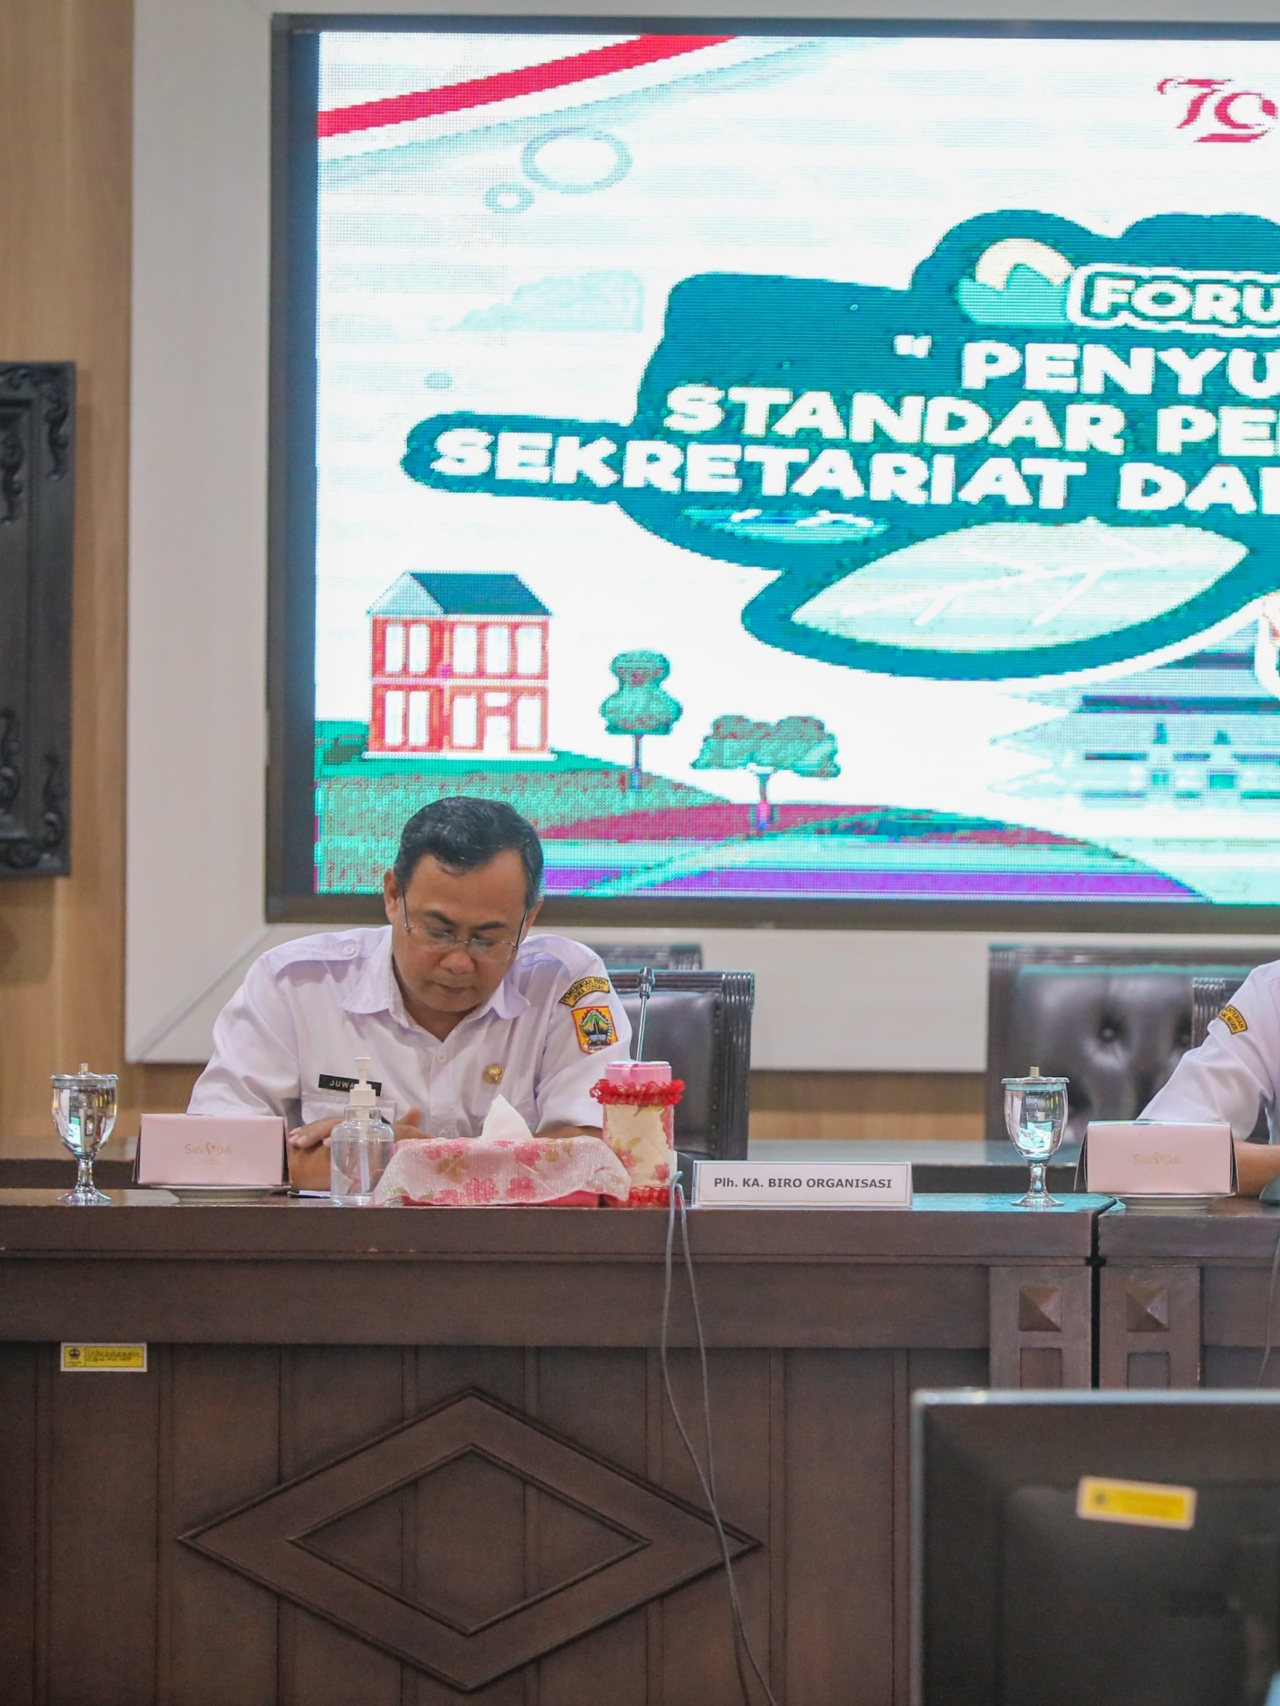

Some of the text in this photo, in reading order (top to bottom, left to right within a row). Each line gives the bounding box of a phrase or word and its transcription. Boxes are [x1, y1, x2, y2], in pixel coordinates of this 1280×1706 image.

[664, 385, 1125, 456] STANDAR
[433, 429, 1087, 510] SEKRETARIAT
[329, 1080, 355, 1089] JUWA
[714, 1178, 892, 1189] Plh. KA. BIRO ORGANISASI
